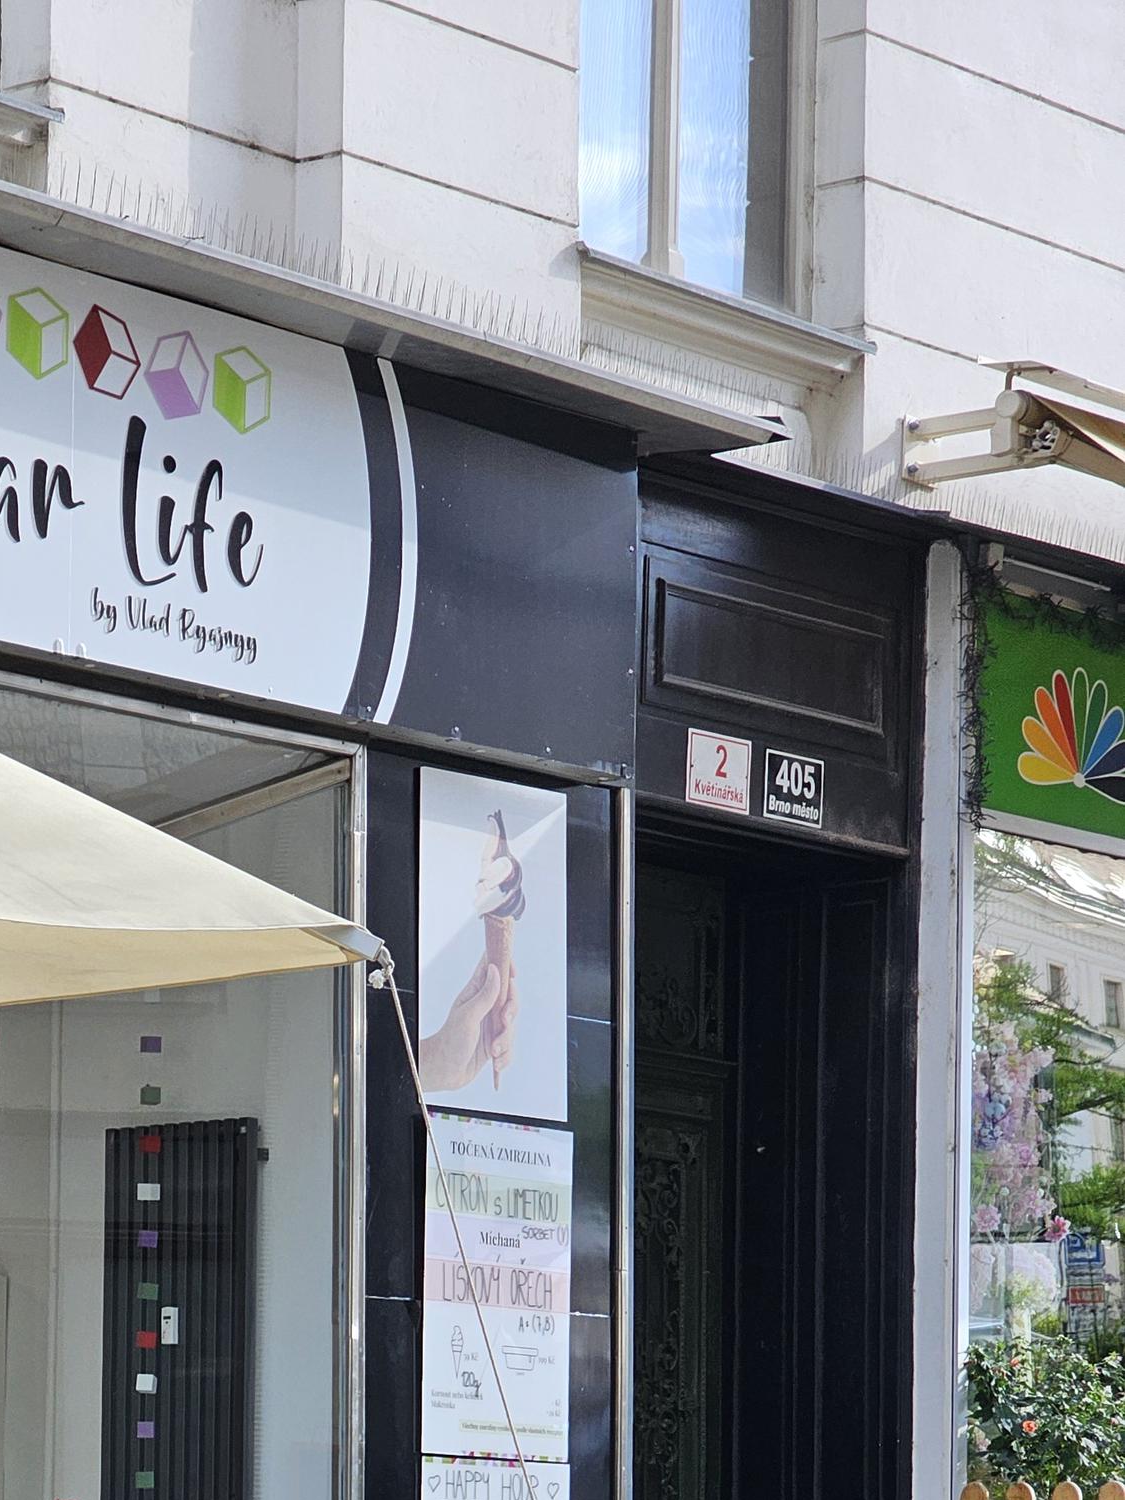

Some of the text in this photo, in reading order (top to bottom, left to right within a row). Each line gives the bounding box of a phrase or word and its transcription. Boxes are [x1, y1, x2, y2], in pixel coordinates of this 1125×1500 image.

[121, 416, 264, 592] Life
[91, 587, 117, 633] by
[126, 596, 171, 637] Vlad
[715, 745, 727, 778] 2
[695, 779, 744, 803] Květinářská
[775, 759, 815, 799] 405
[769, 794, 819, 820] Brno město
[450, 1139, 552, 1167] TOČENÁ ZMRZLINA
[507, 1187, 559, 1221] LIMETKOU
[479, 1231, 521, 1249] Míchaná
[521, 1225, 555, 1241] SORBET
[510, 1257, 553, 1310] OŘECH
[445, 1469, 490, 1500] HAPPY
